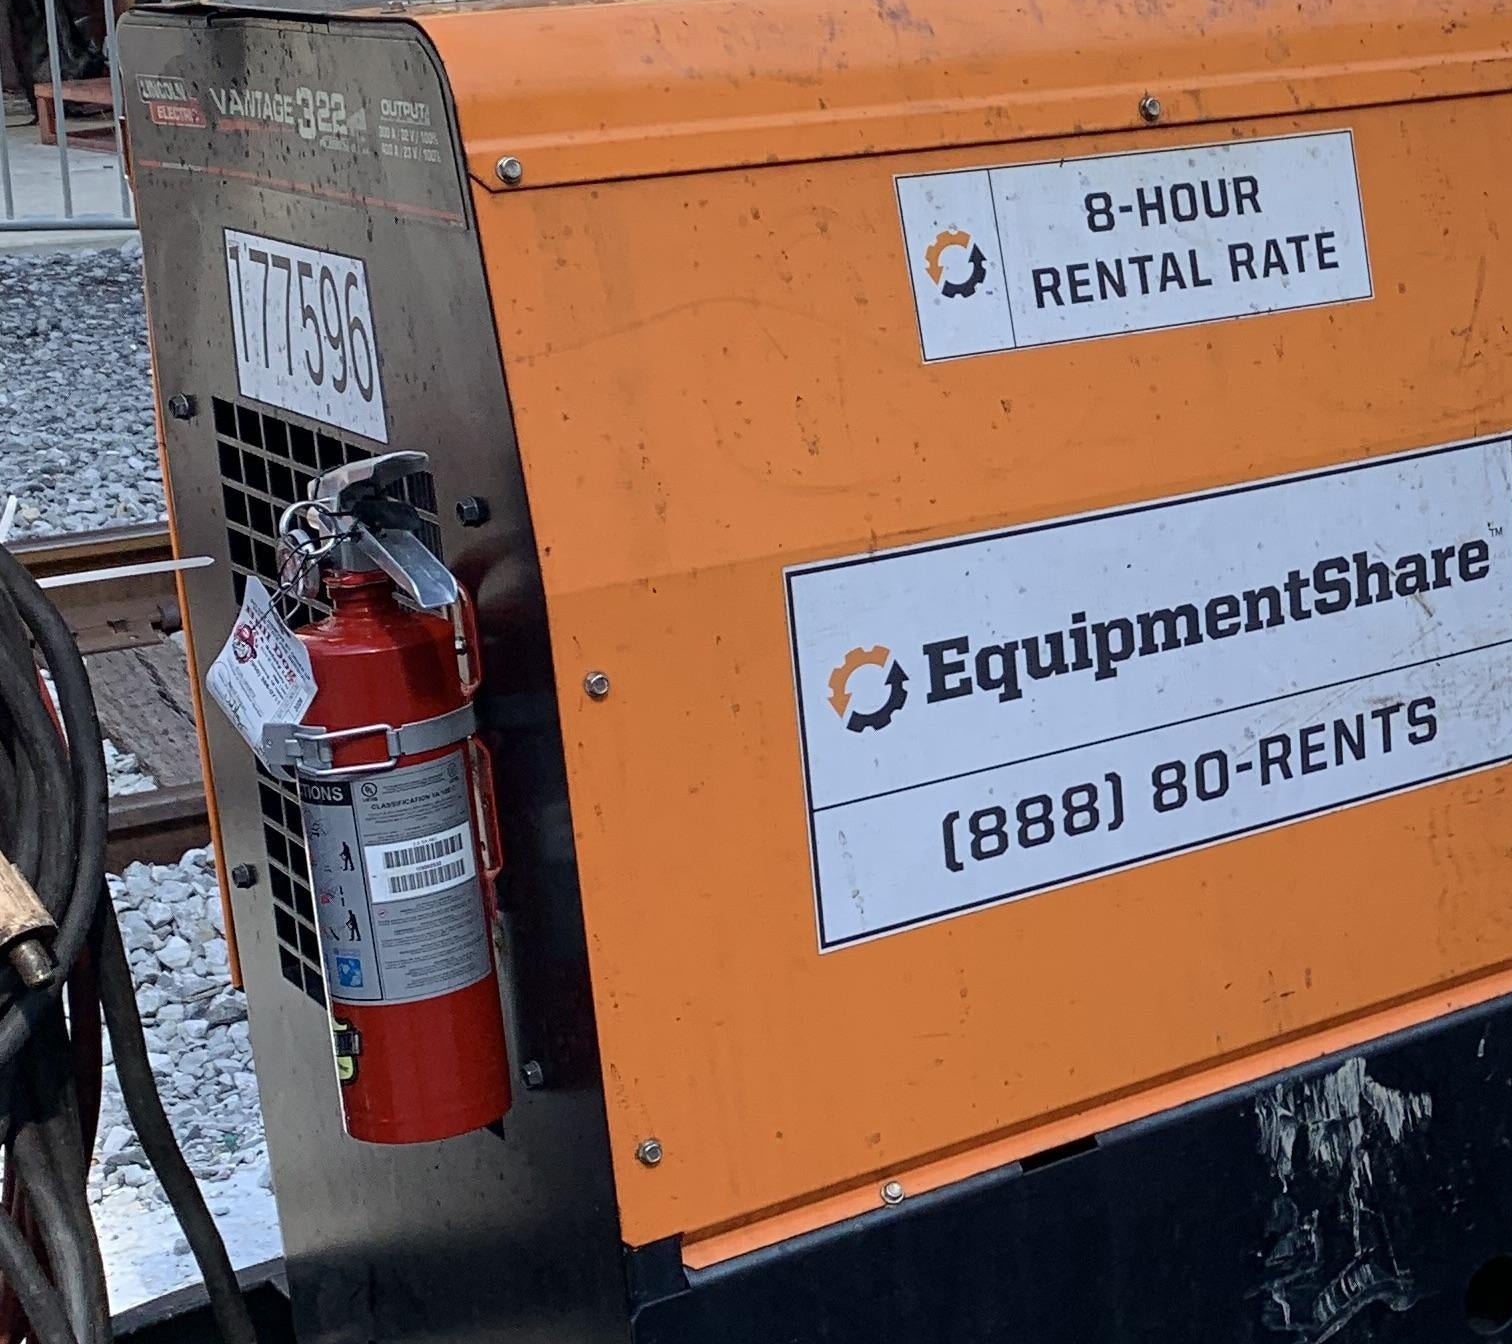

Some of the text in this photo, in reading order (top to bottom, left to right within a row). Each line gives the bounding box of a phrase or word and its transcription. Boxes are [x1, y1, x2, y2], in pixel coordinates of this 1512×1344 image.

[209, 87, 348, 140] VANTAGE 322
[381, 99, 426, 119] OUTPUT
[1085, 175, 1263, 233] 8-HOUR
[1032, 231, 1340, 309] RENTAL RATE
[229, 246, 374, 403] 177596
[923, 539, 1490, 705] EquipmentShare
[943, 696, 1438, 873] (888) 80-RENTS
